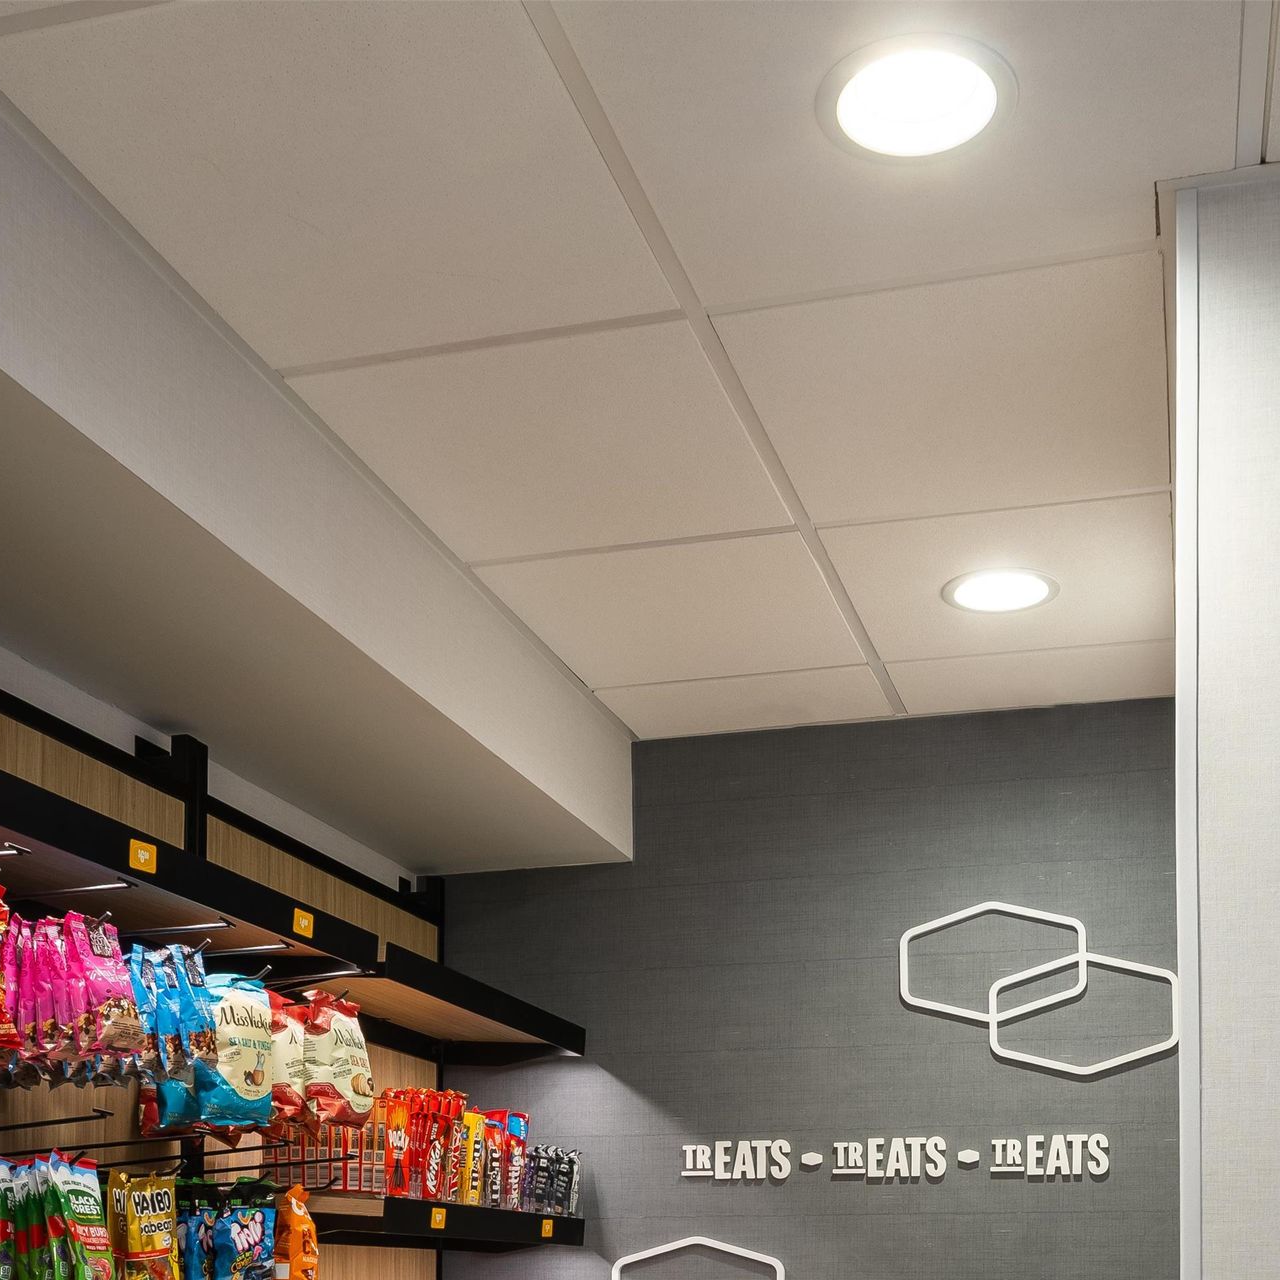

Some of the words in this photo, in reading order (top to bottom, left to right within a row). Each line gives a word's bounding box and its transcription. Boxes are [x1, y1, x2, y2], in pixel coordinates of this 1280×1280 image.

[682, 1139, 791, 1180] TREATS
[832, 1136, 947, 1177] TREATS
[990, 1133, 1109, 1175] TREATS
[70, 1194, 96, 1205] BLACK
